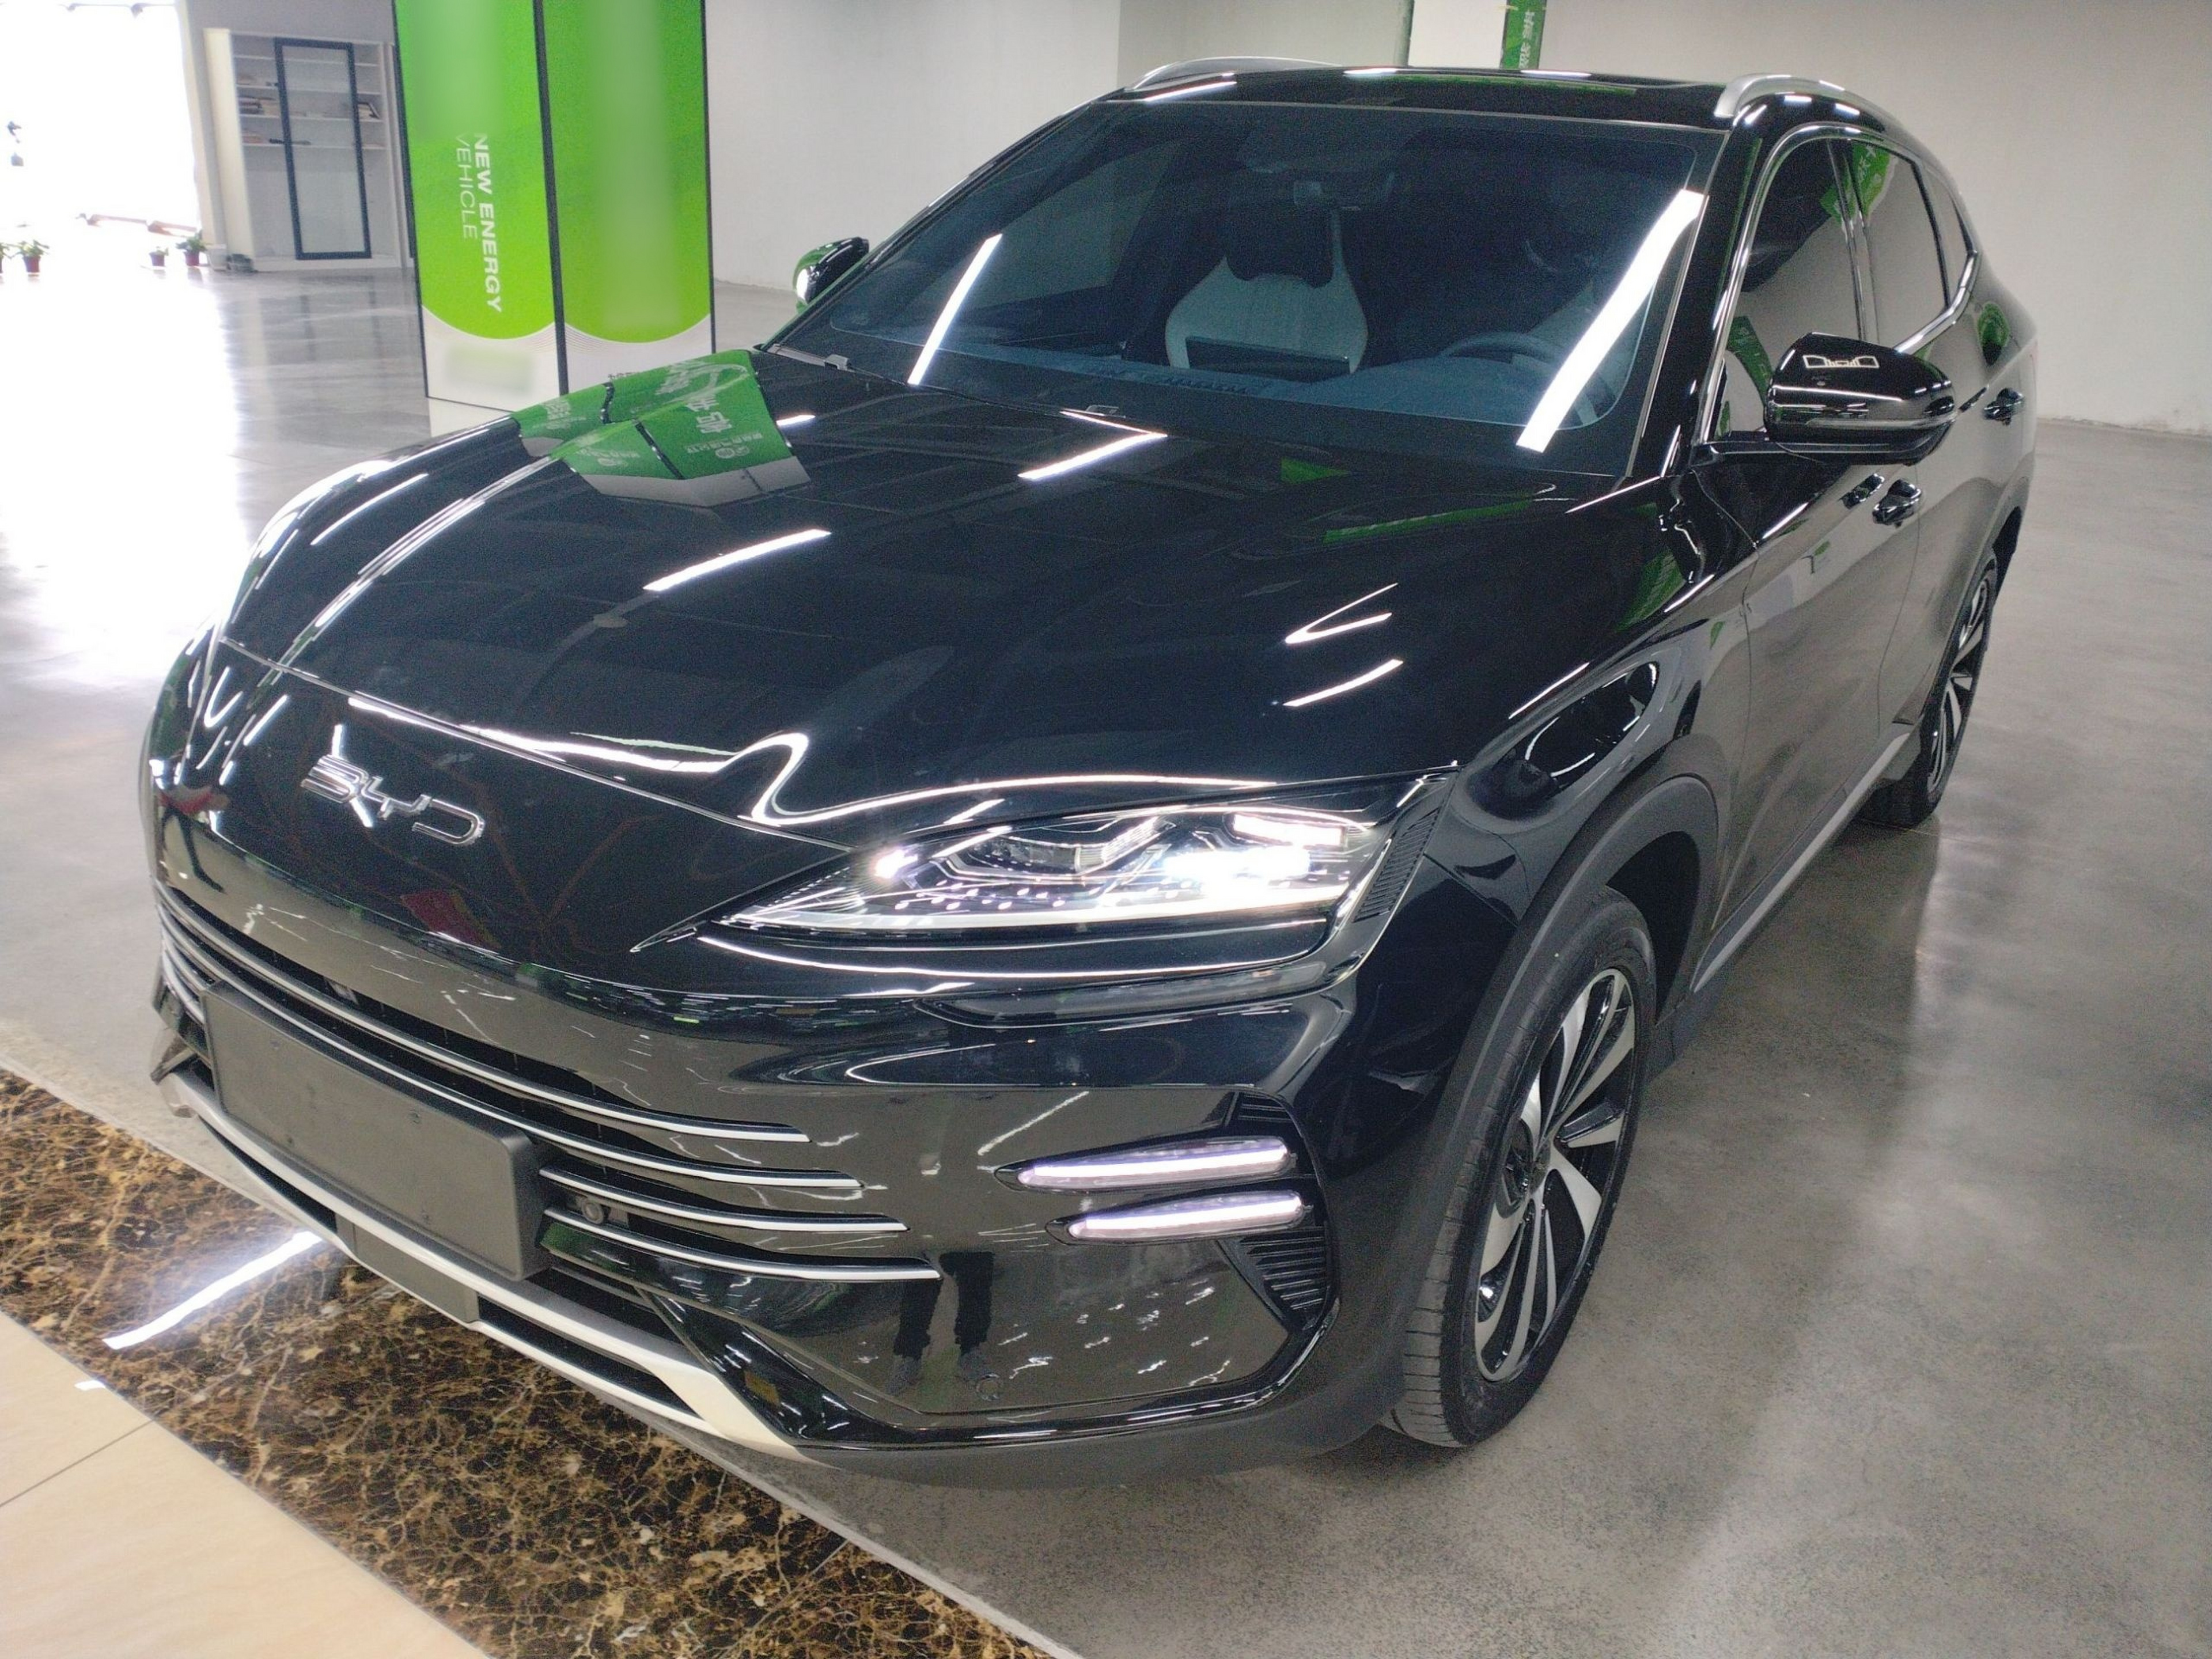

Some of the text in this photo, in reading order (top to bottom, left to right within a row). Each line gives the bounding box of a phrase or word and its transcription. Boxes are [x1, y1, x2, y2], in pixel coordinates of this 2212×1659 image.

[456, 132, 478, 240] VEHICLE
[474, 132, 502, 312] NEW ENERGY
[300, 754, 485, 846] BYD
